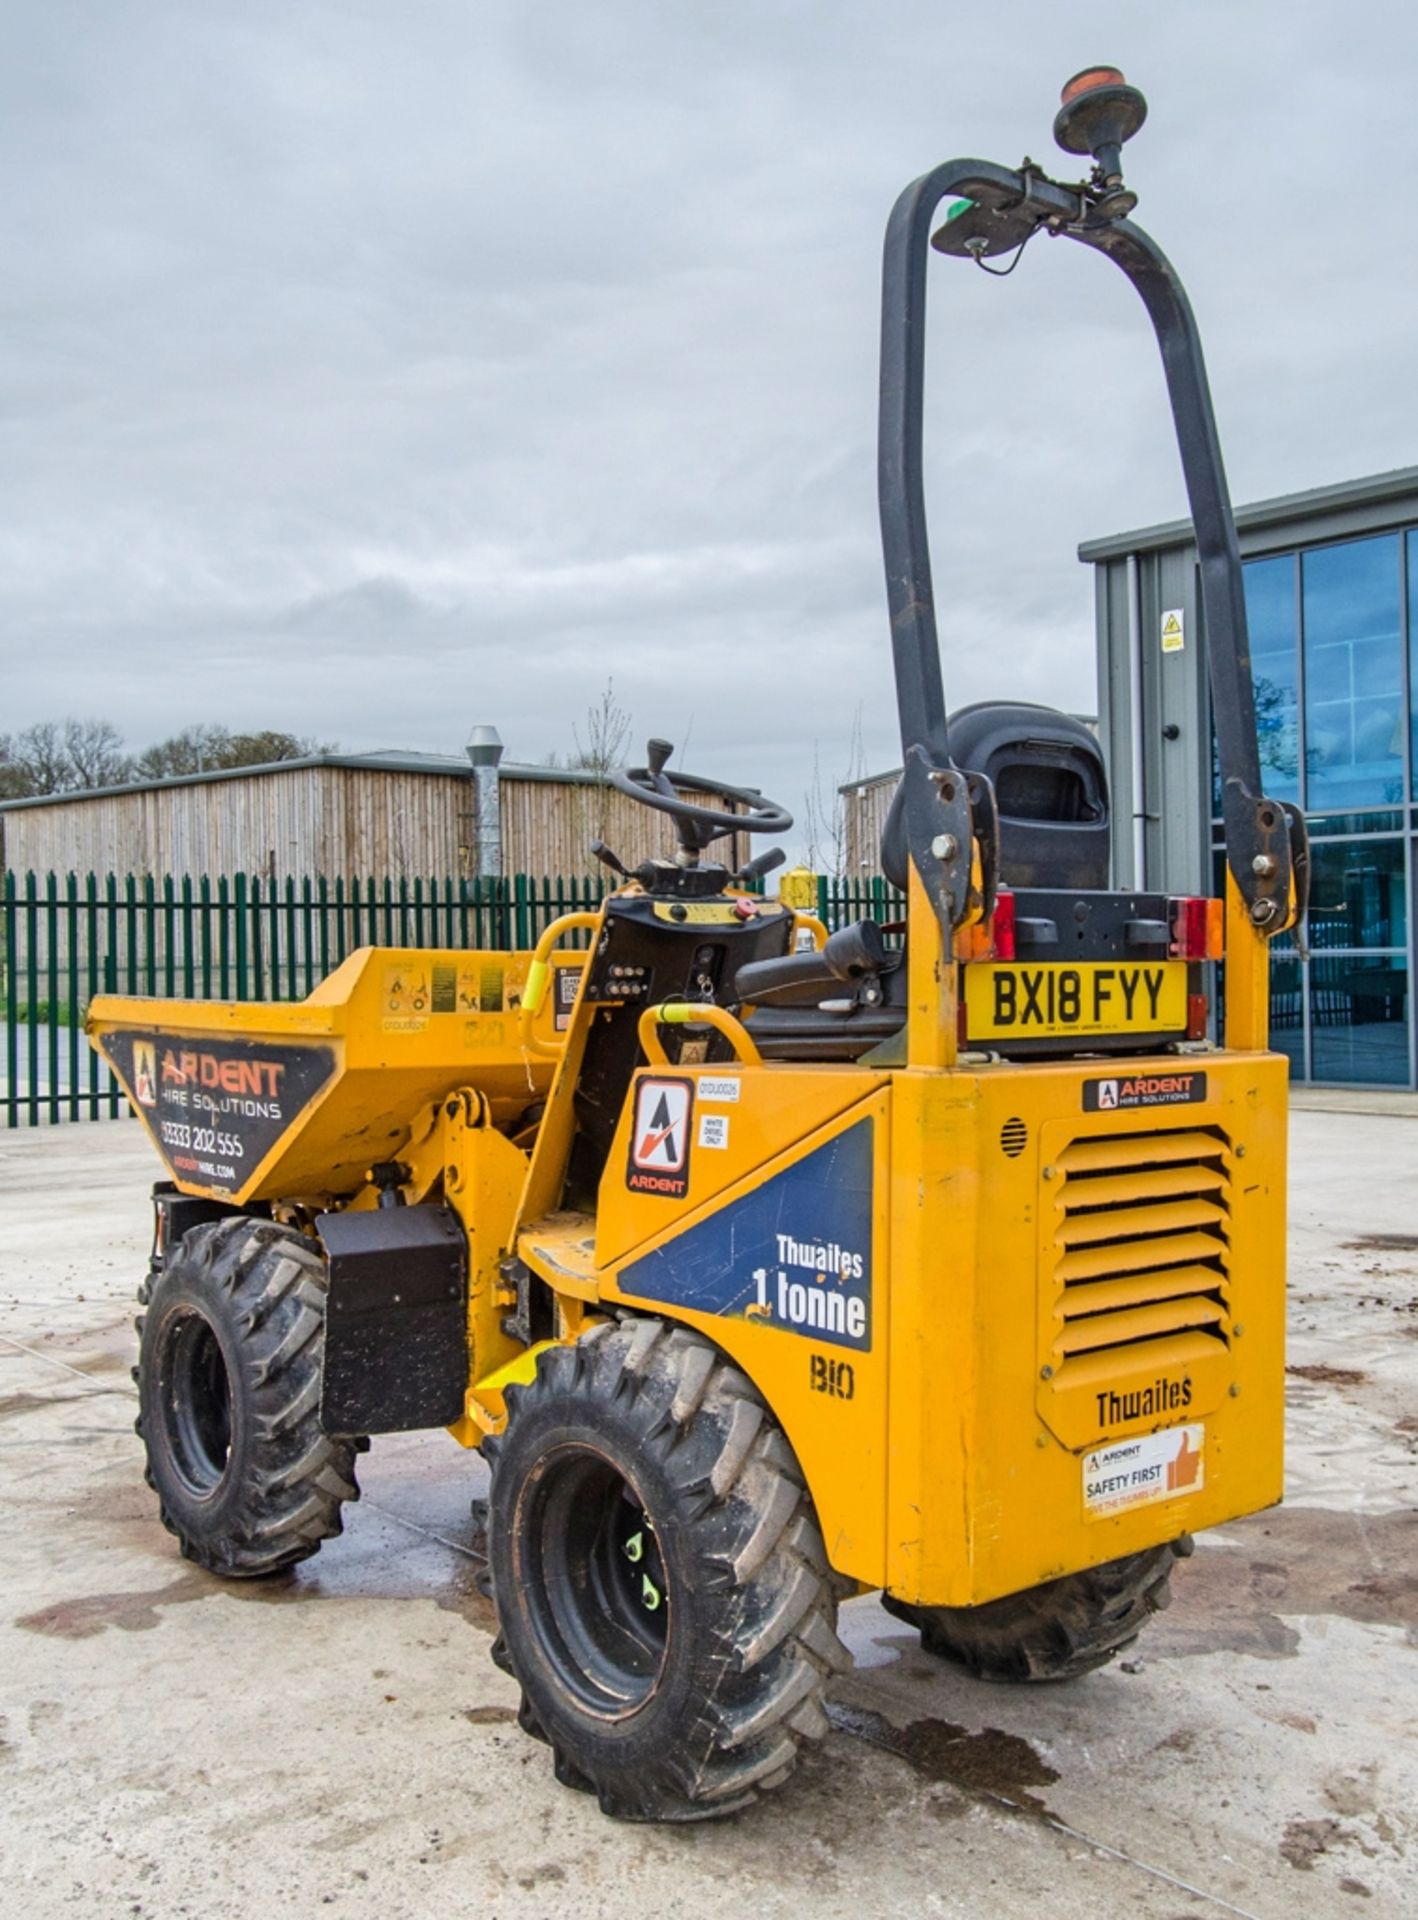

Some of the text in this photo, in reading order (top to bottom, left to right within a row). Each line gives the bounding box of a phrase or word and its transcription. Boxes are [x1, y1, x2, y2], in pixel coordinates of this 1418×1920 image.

[993, 969, 1164, 1026] BX18 FYY
[161, 1049, 285, 1098] ARDENT
[1120, 1076, 1193, 1097] ARDENT
[162, 1089, 282, 1119] HIRE SOLUTIONS
[1119, 1092, 1191, 1106] HIRE SOLUTIONS
[192, 1126, 217, 1154] 202
[217, 1131, 244, 1157] 555
[629, 1174, 685, 1193] ARDENT
[776, 1233, 863, 1279] Thwaites
[752, 1268, 866, 1339] 1 tonne
[1096, 1377, 1193, 1428] Thwaites
[1102, 1445, 1141, 1463] ARDENT
[1086, 1464, 1163, 1498] SAFETY FIRST
